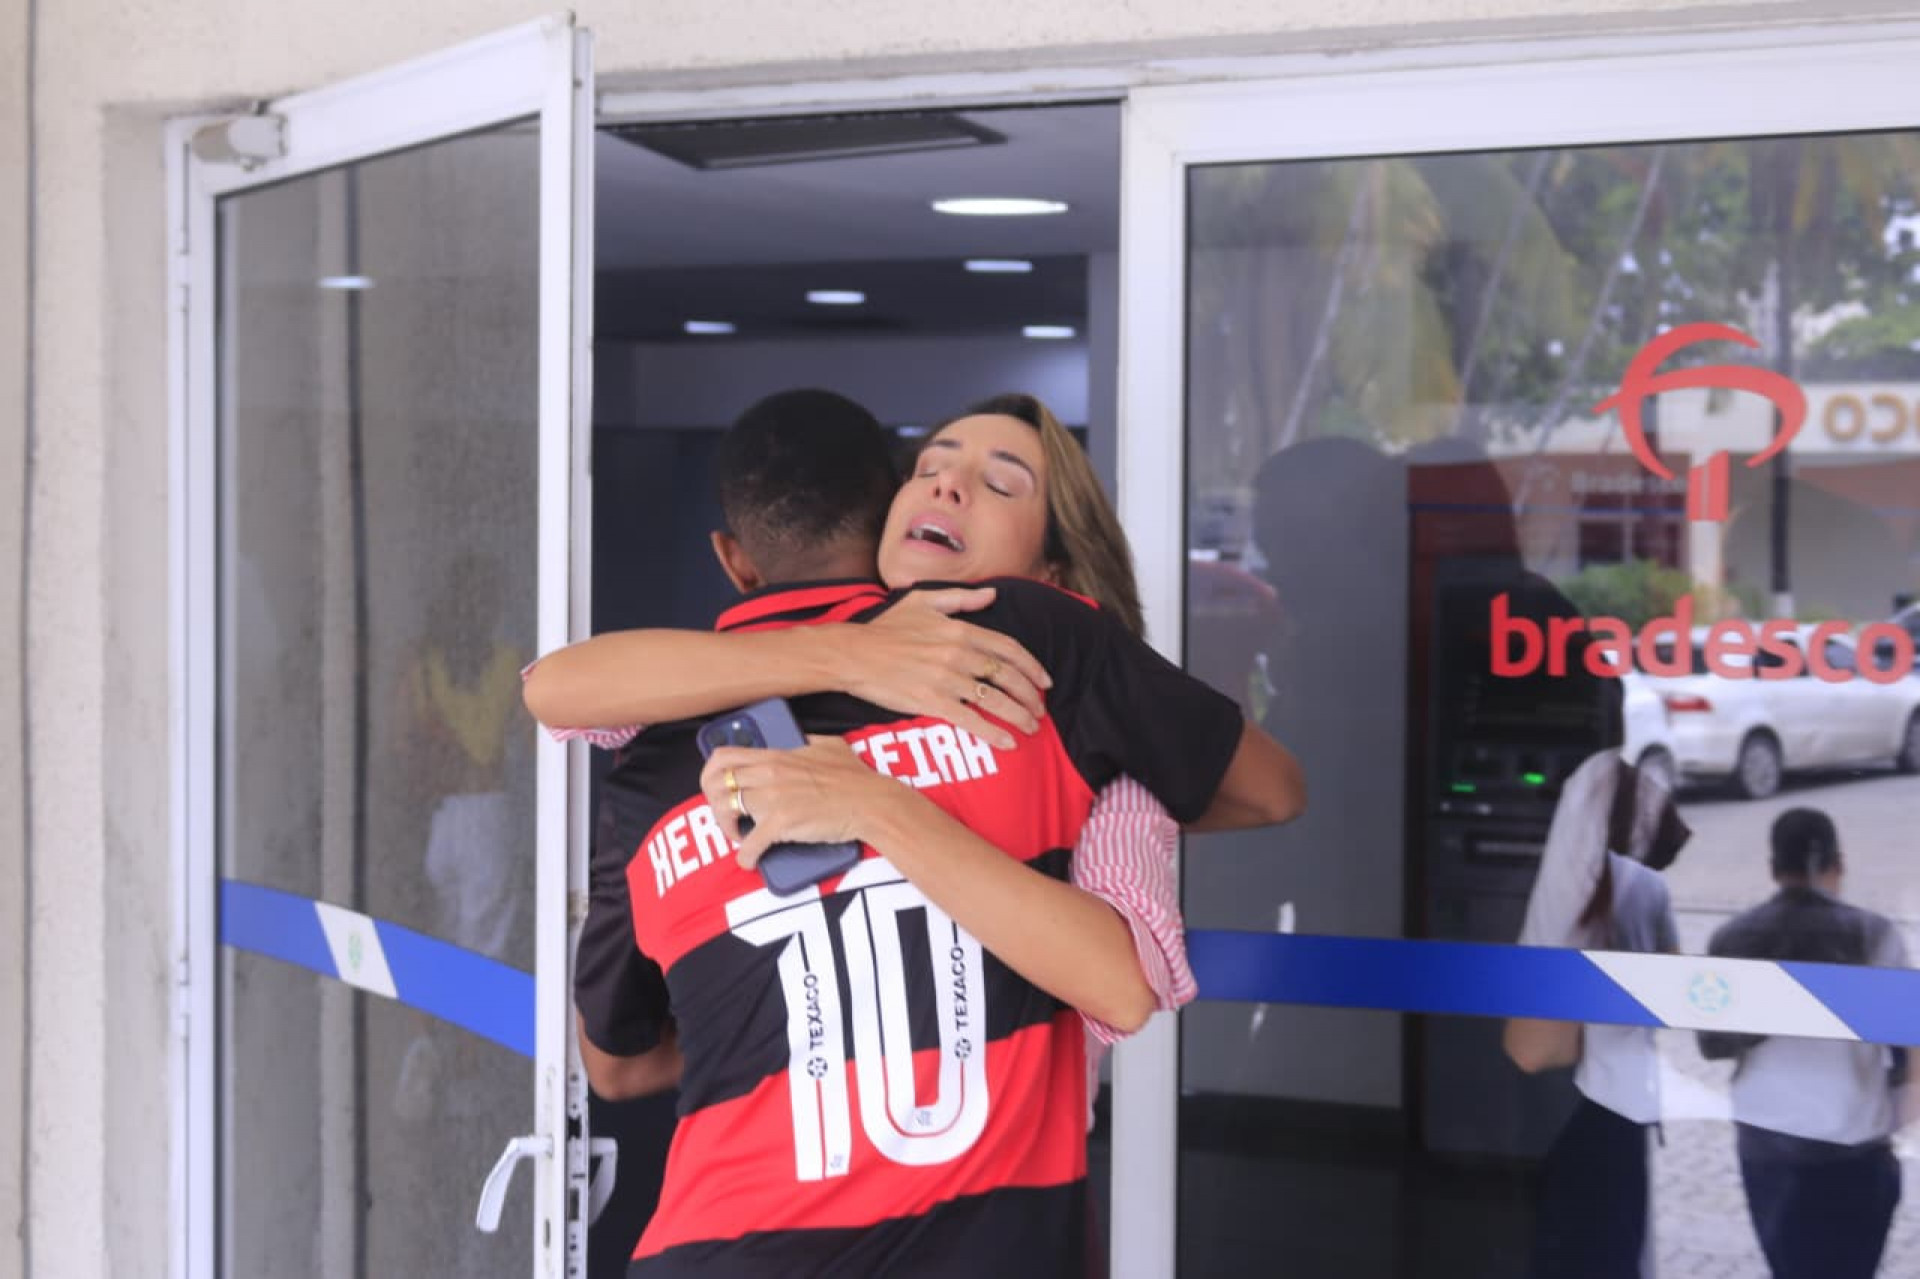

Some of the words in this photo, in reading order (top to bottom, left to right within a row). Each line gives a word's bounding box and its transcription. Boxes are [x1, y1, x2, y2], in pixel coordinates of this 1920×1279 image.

[1490, 593, 1915, 684] bradesco
[851, 723, 999, 788] EIRA
[724, 856, 990, 1182] 10
[803, 973, 824, 1051] TEXACO
[950, 946, 970, 1033] TEXACO
